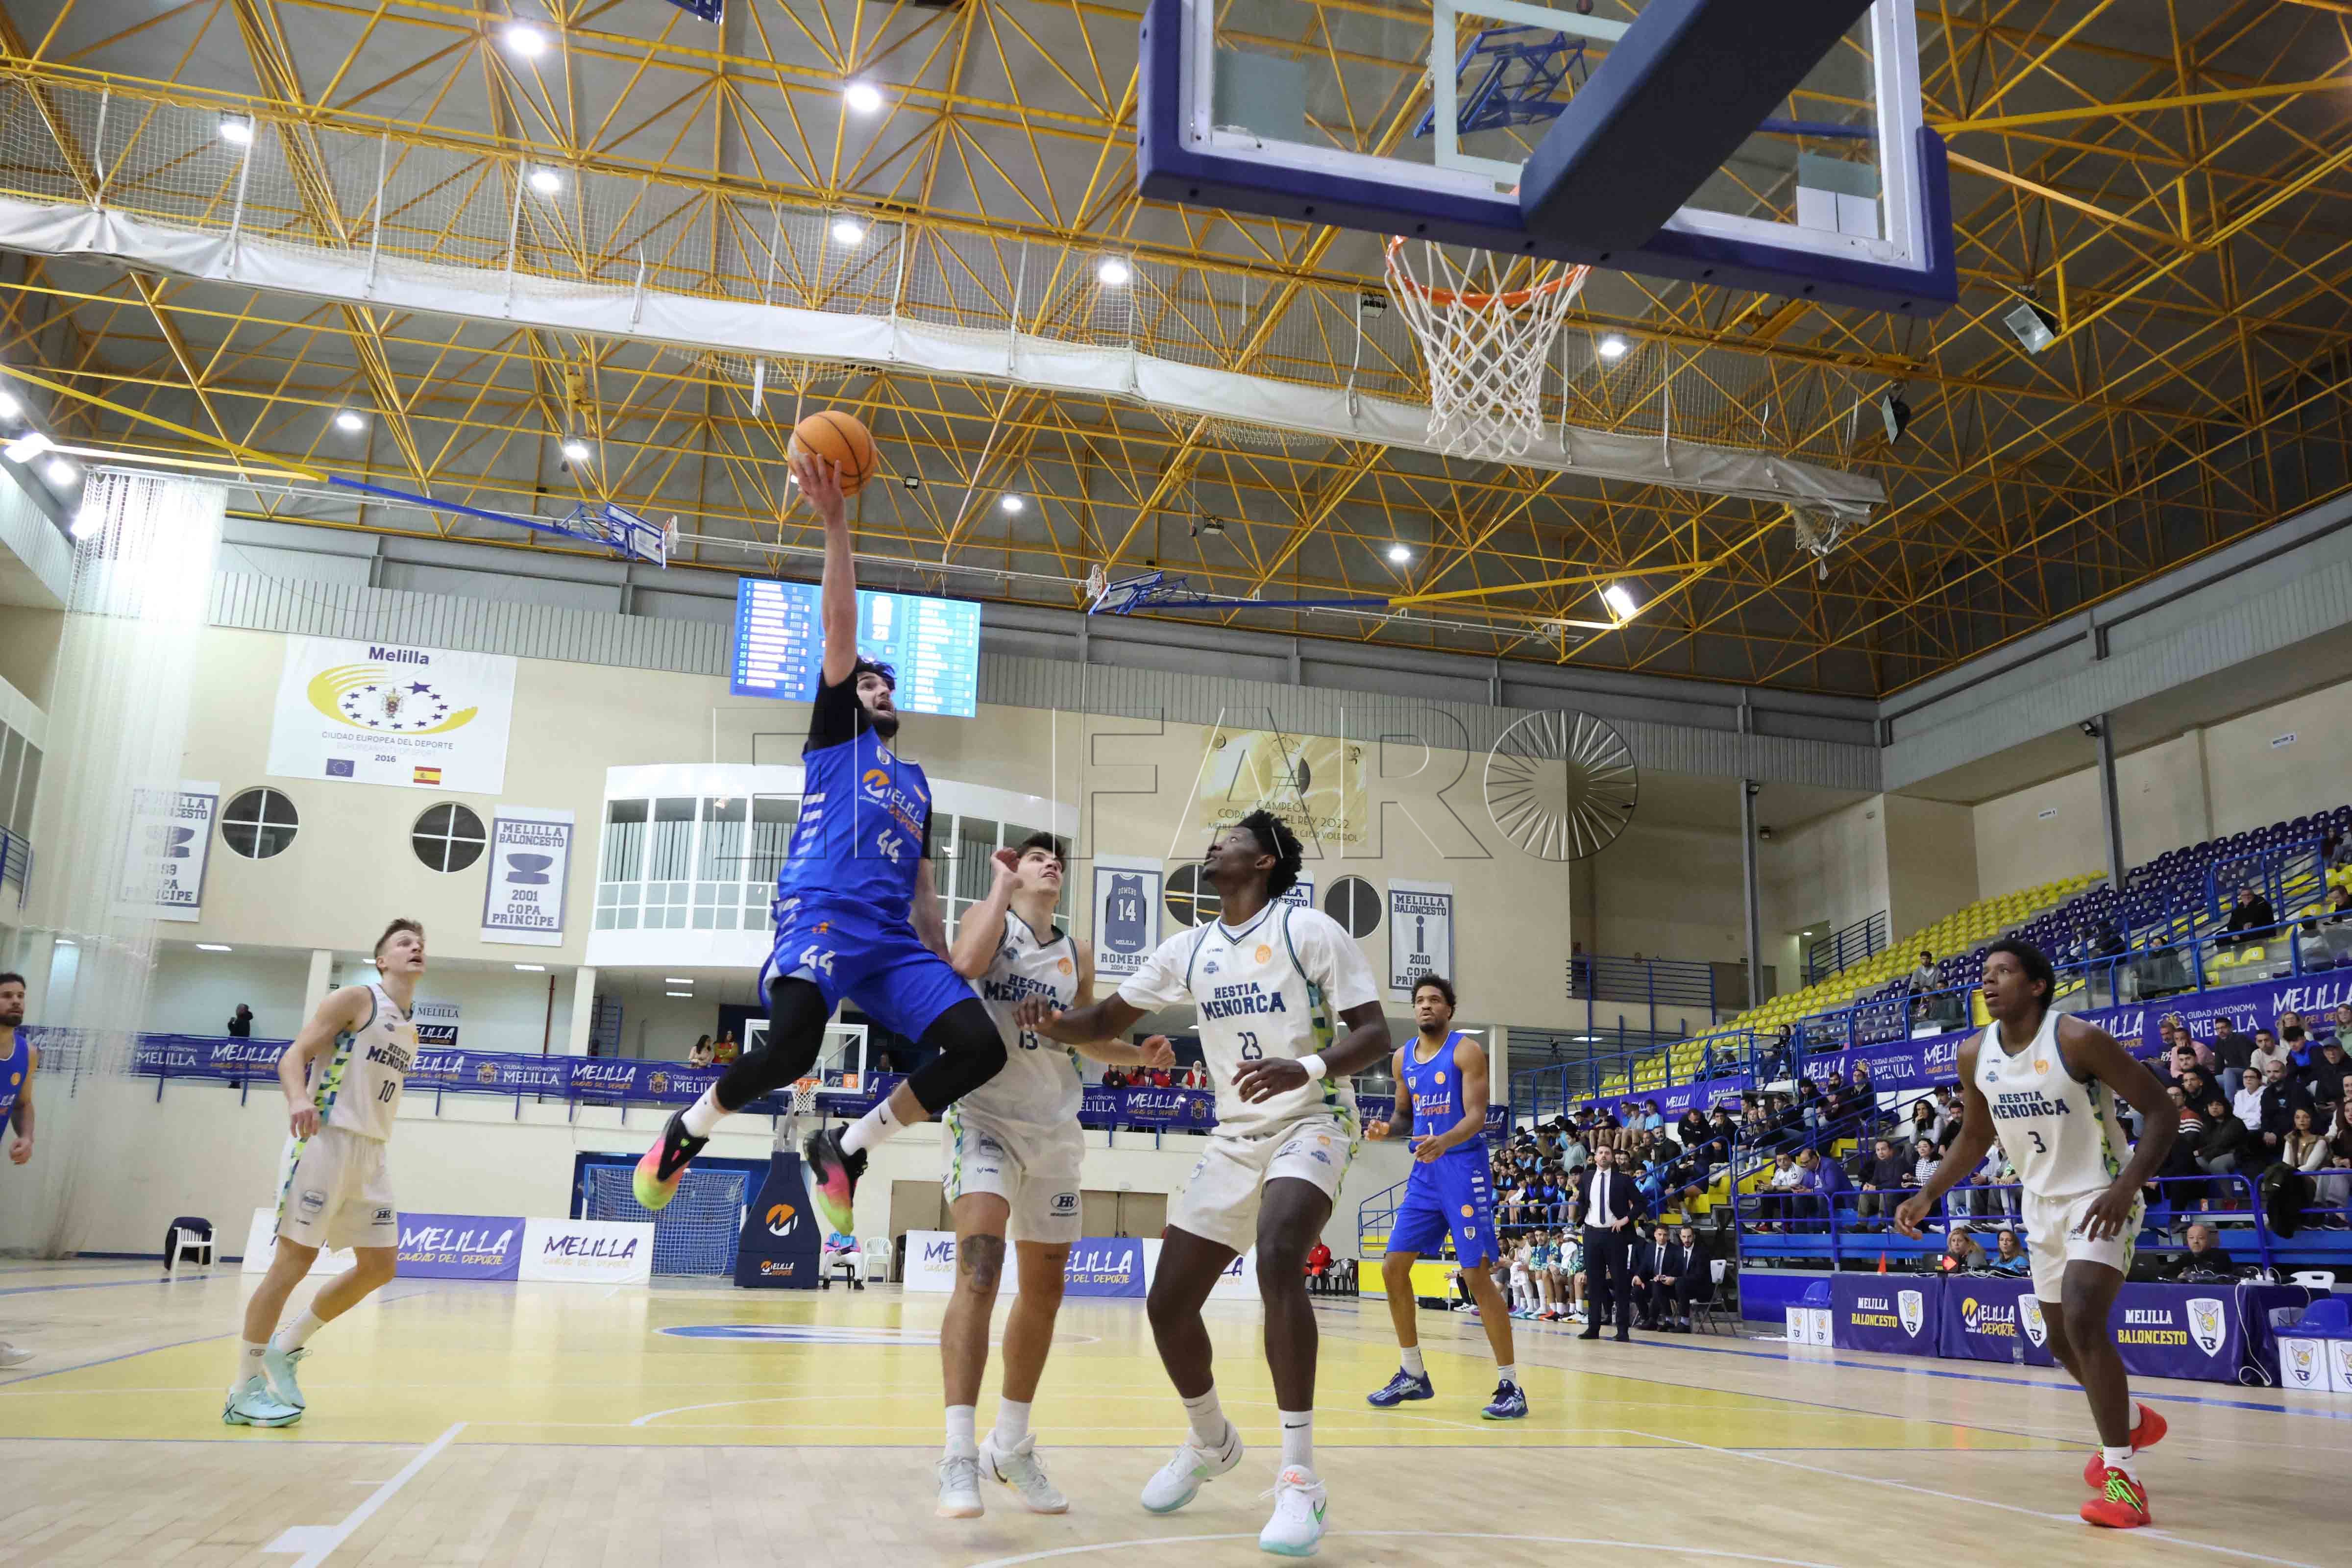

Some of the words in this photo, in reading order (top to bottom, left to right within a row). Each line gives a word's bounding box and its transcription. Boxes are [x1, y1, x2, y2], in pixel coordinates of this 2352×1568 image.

[368, 647, 430, 665] Melilla
[322, 732, 354, 741] CIUDAD
[356, 735, 395, 744] EUROPEA
[397, 737, 413, 746] DEL
[415, 740, 454, 750] DEPORTE
[1256, 800, 1310, 813] CAMPEÓN
[1218, 808, 1246, 819] COPA
[1321, 817, 1349, 829] 2022
[503, 823, 562, 837] MELILLA
[499, 833, 564, 847] BALONCESTO
[877, 828, 903, 864] 44
[512, 890, 538, 902] 2001
[1396, 895, 1445, 906] MELILLA
[507, 904, 540, 915] COPA
[1118, 899, 1136, 922] 14
[1394, 904, 1446, 916] BALONCESTO
[492, 913, 554, 927] PRINCIPE
[799, 945, 836, 977] 44
[1409, 954, 1430, 965] 2010
[1008, 973, 1056, 998] HESTIA
[1214, 982, 1261, 999] HESTIA
[417, 1007, 459, 1018] MELILLA
[1200, 992, 1286, 1021] MENORCA
[2187, 1008, 2211, 1020] CIUDAD
[2214, 1003, 2257, 1016] AUTÓNOMA
[1019, 1030, 1039, 1050] 13
[1237, 1031, 1263, 1060] 23
[137, 1052, 196, 1066] MELILLA
[211, 1044, 282, 1063] MELILLA
[388, 1043, 411, 1061] HESTIA
[1888, 1055, 1913, 1064] AUTÓNOMA
[409, 1055, 464, 1073] ELILLA
[1875, 1063, 1915, 1080] MELILLA
[503, 1072, 560, 1085] MELILLA
[571, 1064, 637, 1082] MELILLA
[378, 1079, 396, 1103] 10
[1998, 1091, 2044, 1103] HESTIA
[1079, 1101, 1117, 1113] ELILLA
[1127, 1093, 1182, 1109] MELILLA
[1666, 1093, 1690, 1109] MELILLA
[1991, 1099, 2070, 1120] MENORCA
[1427, 1122, 1434, 1136] 1
[2028, 1131, 2047, 1153] 3
[398, 1226, 514, 1253] MELILLA
[543, 1235, 638, 1259] MELILLA
[397, 1252, 436, 1262] CIUDAD
[439, 1254, 458, 1263] DEL
[462, 1254, 504, 1266] DEPORTE
[1074, 1274, 1090, 1282] DEL
[1093, 1274, 1130, 1283] DEPORTE
[1858, 1298, 1888, 1310] MELILLA
[1851, 1313, 1898, 1328] BALONCESTO
[1962, 1298, 2015, 1327] MELILLA
[2125, 1309, 2173, 1324] MELILLA
[1982, 1323, 2015, 1337] DEPORTE
[2117, 1329, 2187, 1345] BALONCESTO
